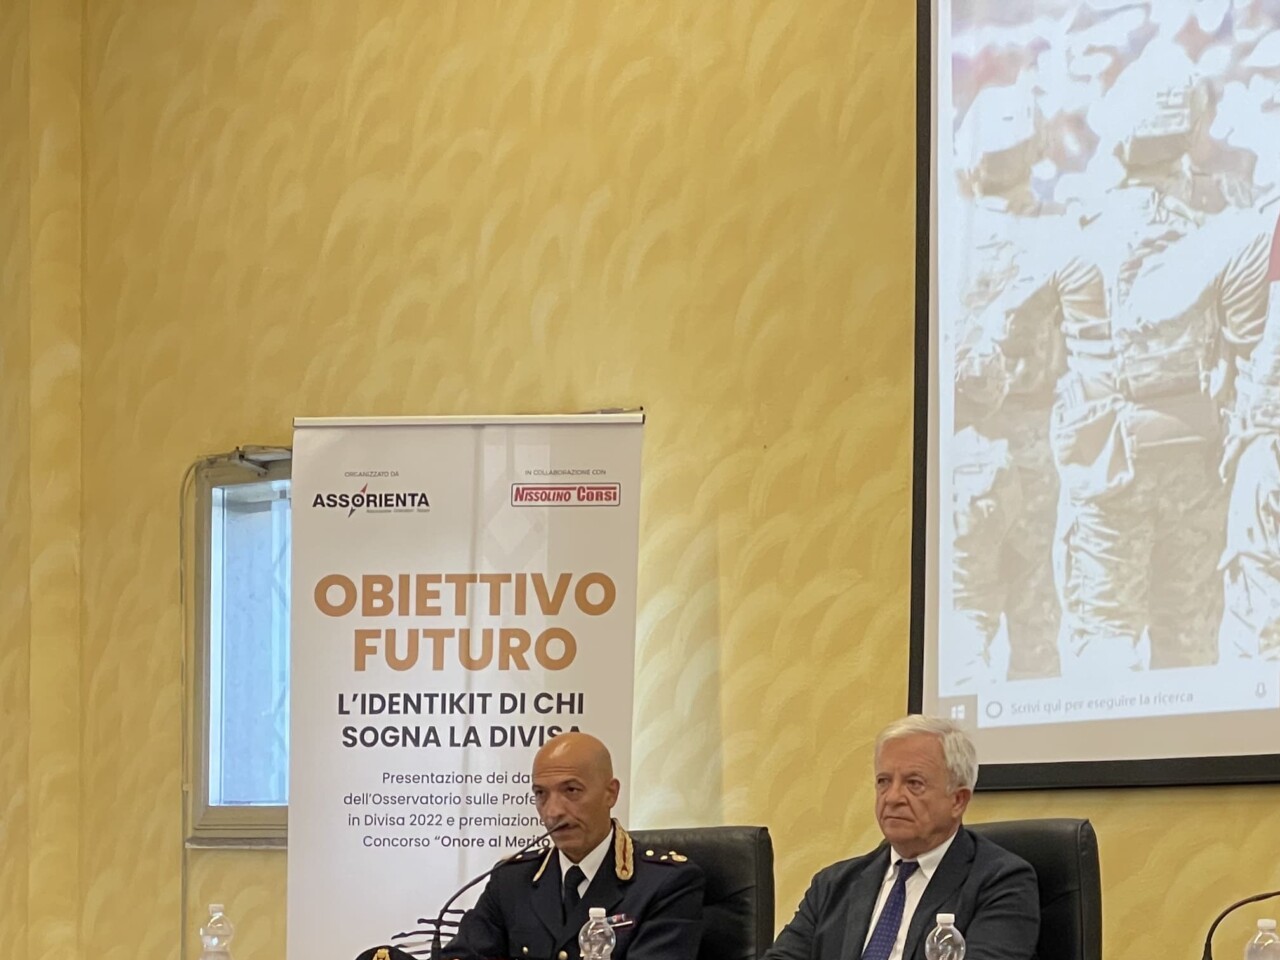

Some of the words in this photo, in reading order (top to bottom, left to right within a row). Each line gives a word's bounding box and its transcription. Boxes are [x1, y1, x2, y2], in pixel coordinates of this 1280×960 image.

[312, 493, 430, 508] ASSORIENTA
[514, 486, 573, 502] NISSOLINO
[577, 486, 617, 502] CORSI
[313, 572, 617, 617] OBIETTIVO
[353, 627, 578, 672] FUTURO
[338, 692, 493, 715] L’IDENTIKIT
[499, 692, 525, 715] DI
[533, 692, 585, 715] CHI
[1010, 700, 1041, 715] Scrivi
[1043, 700, 1062, 715] qui
[1064, 700, 1083, 713] per
[1087, 695, 1137, 710] eseguire
[1139, 693, 1151, 706] la
[1153, 692, 1194, 704] ricerca
[342, 726, 442, 748] SOGNA
[449, 726, 482, 747] LA
[382, 771, 483, 784] Presentazione
[486, 771, 508, 784] dei
[511, 772, 530, 784] da
[343, 793, 462, 806] dell’Osservatorio
[465, 793, 499, 805] sulle
[502, 793, 537, 806] Profe
[348, 814, 360, 826] in
[364, 814, 406, 826] Divisa
[409, 814, 442, 826] 2022
[446, 817, 455, 826] e
[362, 836, 430, 848] Concorso
[489, 835, 502, 847] al
